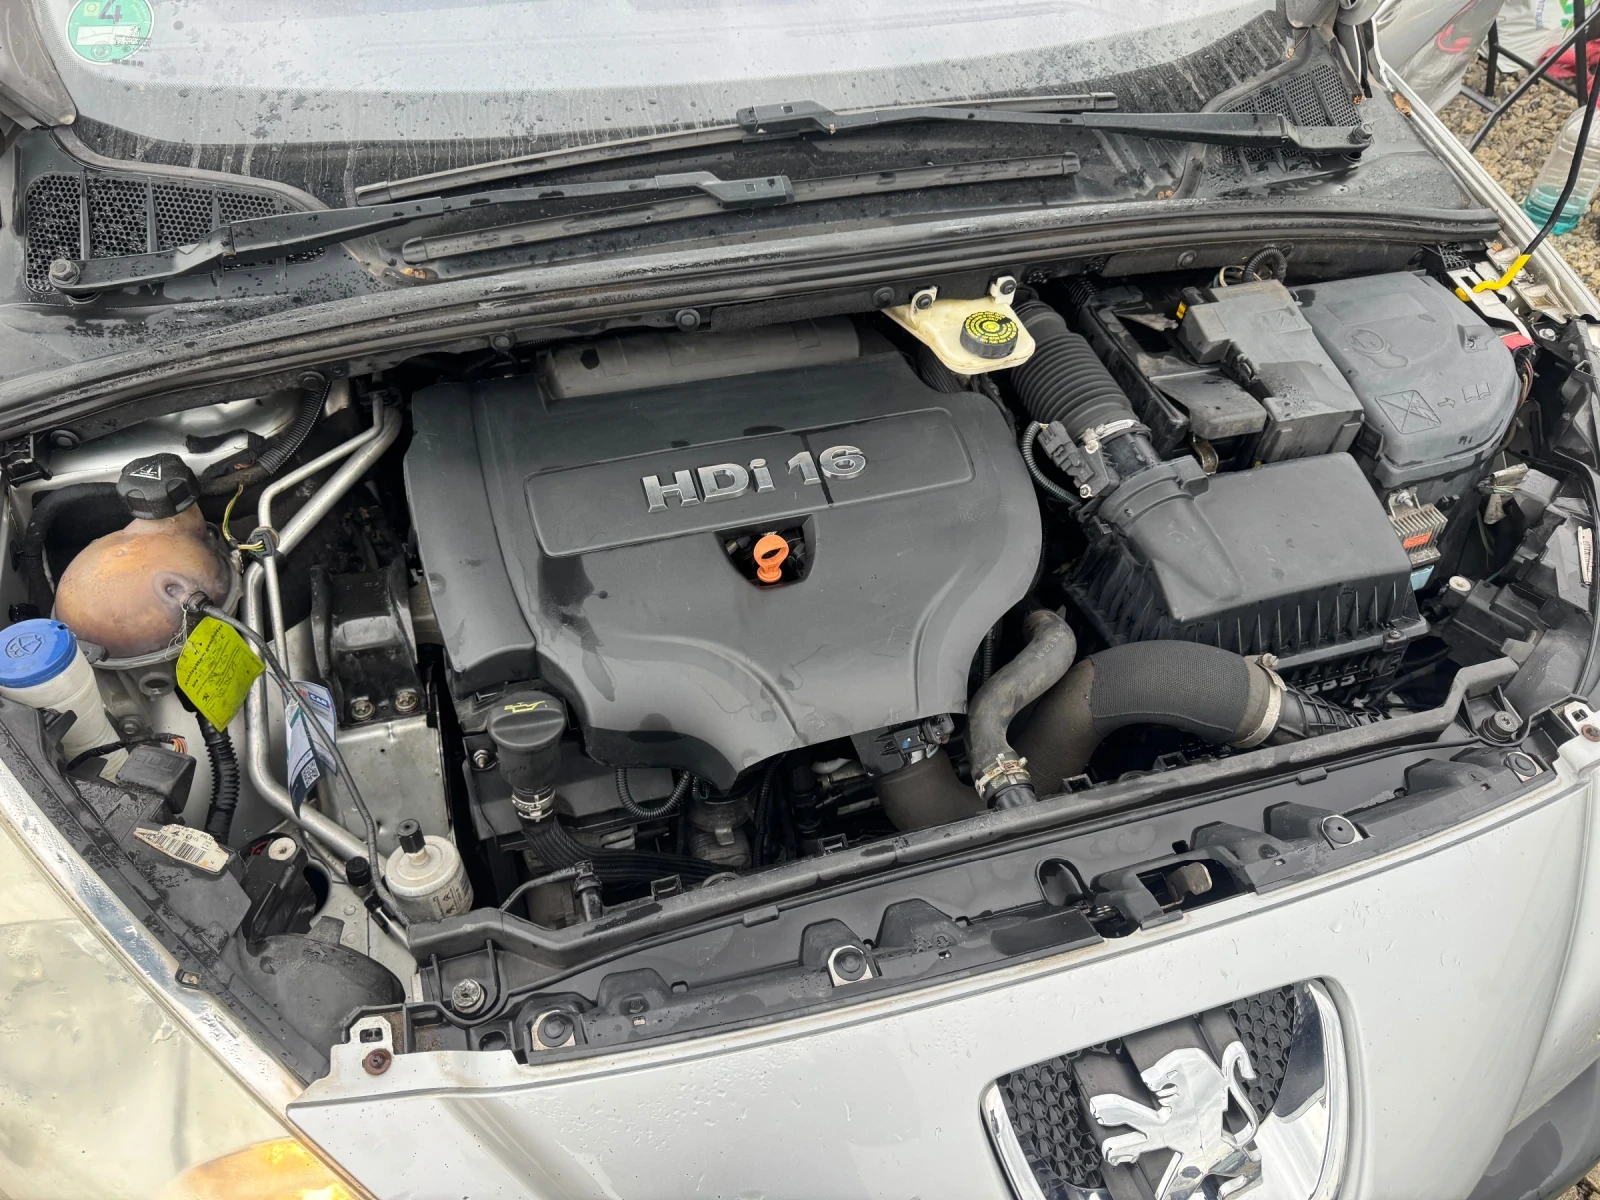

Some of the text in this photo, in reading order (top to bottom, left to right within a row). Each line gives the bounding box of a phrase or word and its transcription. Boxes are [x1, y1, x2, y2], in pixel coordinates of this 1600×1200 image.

[98, 0, 123, 24] 4
[641, 445, 868, 513] HDi 16
